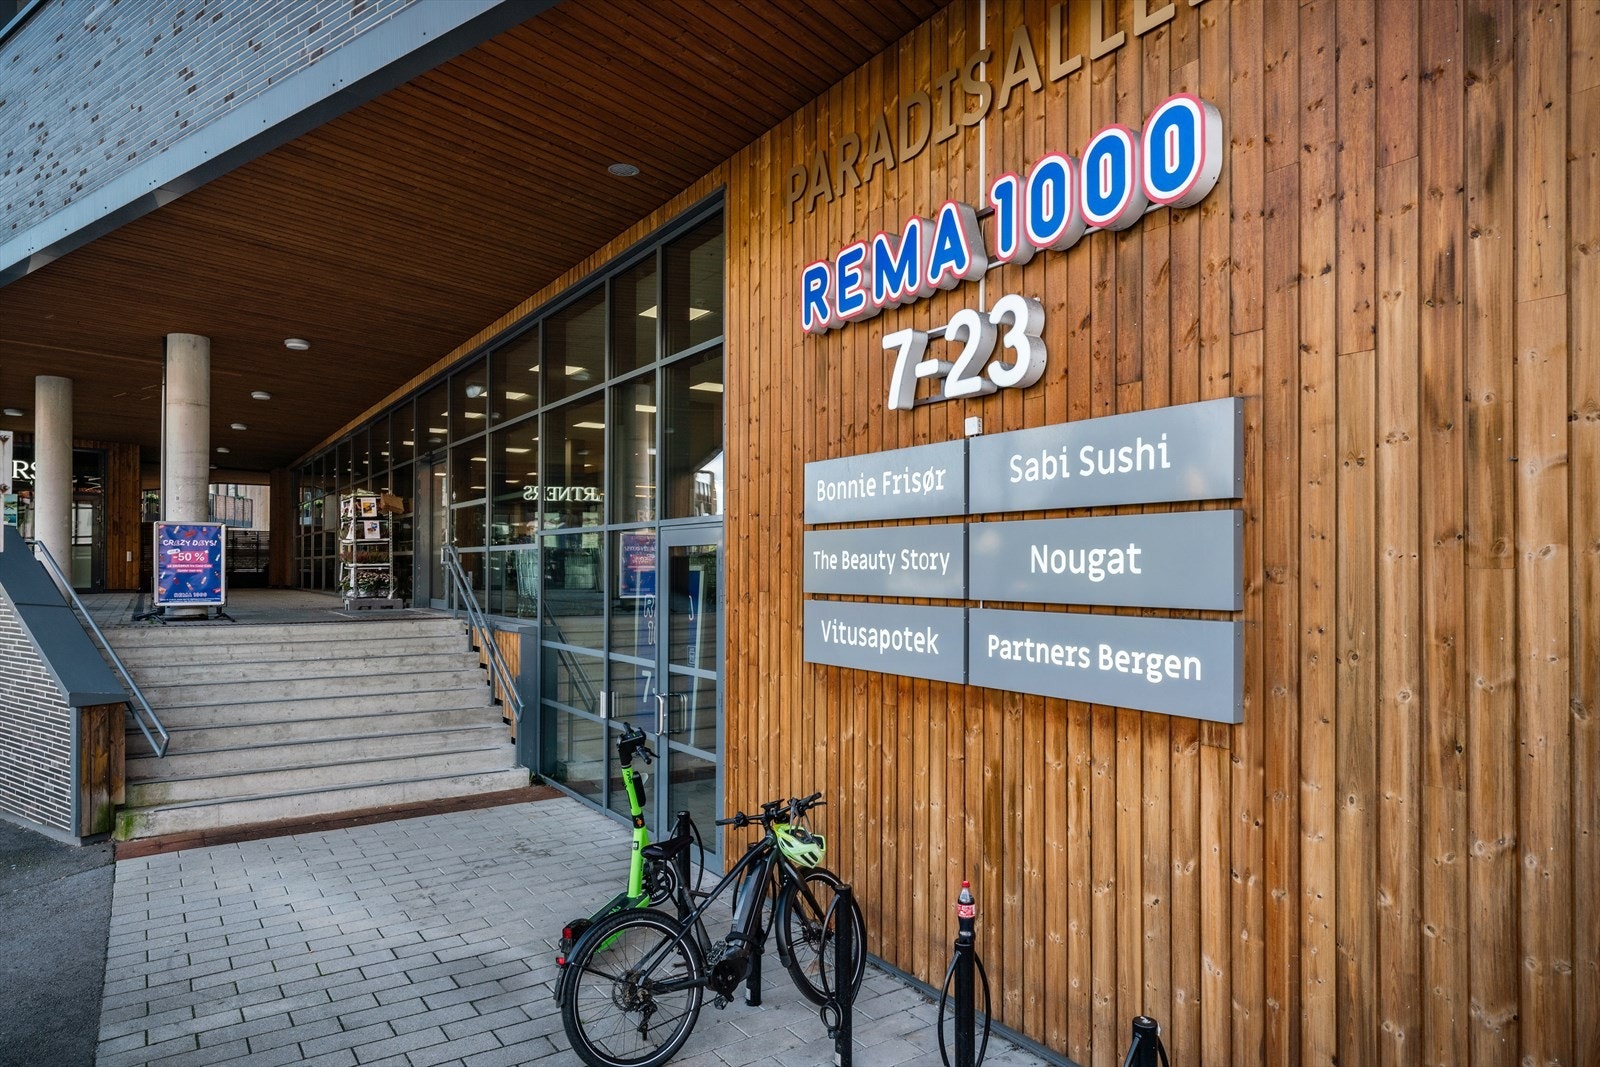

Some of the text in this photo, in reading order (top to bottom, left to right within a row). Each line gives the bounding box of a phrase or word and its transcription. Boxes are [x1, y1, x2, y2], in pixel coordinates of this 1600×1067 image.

[786, 0, 1201, 224] PARADISALL
[801, 93, 1208, 334] REMA 1000
[882, 294, 1034, 410] 7-23
[1009, 433, 1171, 483] Sabi Sushi
[816, 466, 947, 502] Bonnie Frisør
[172, 552, 205, 562] -50 %
[813, 548, 950, 576] The Beauty Story
[1031, 543, 1142, 583] Nougat
[821, 620, 939, 655] Vitusapotek
[988, 634, 1201, 684] Partners Bergen
